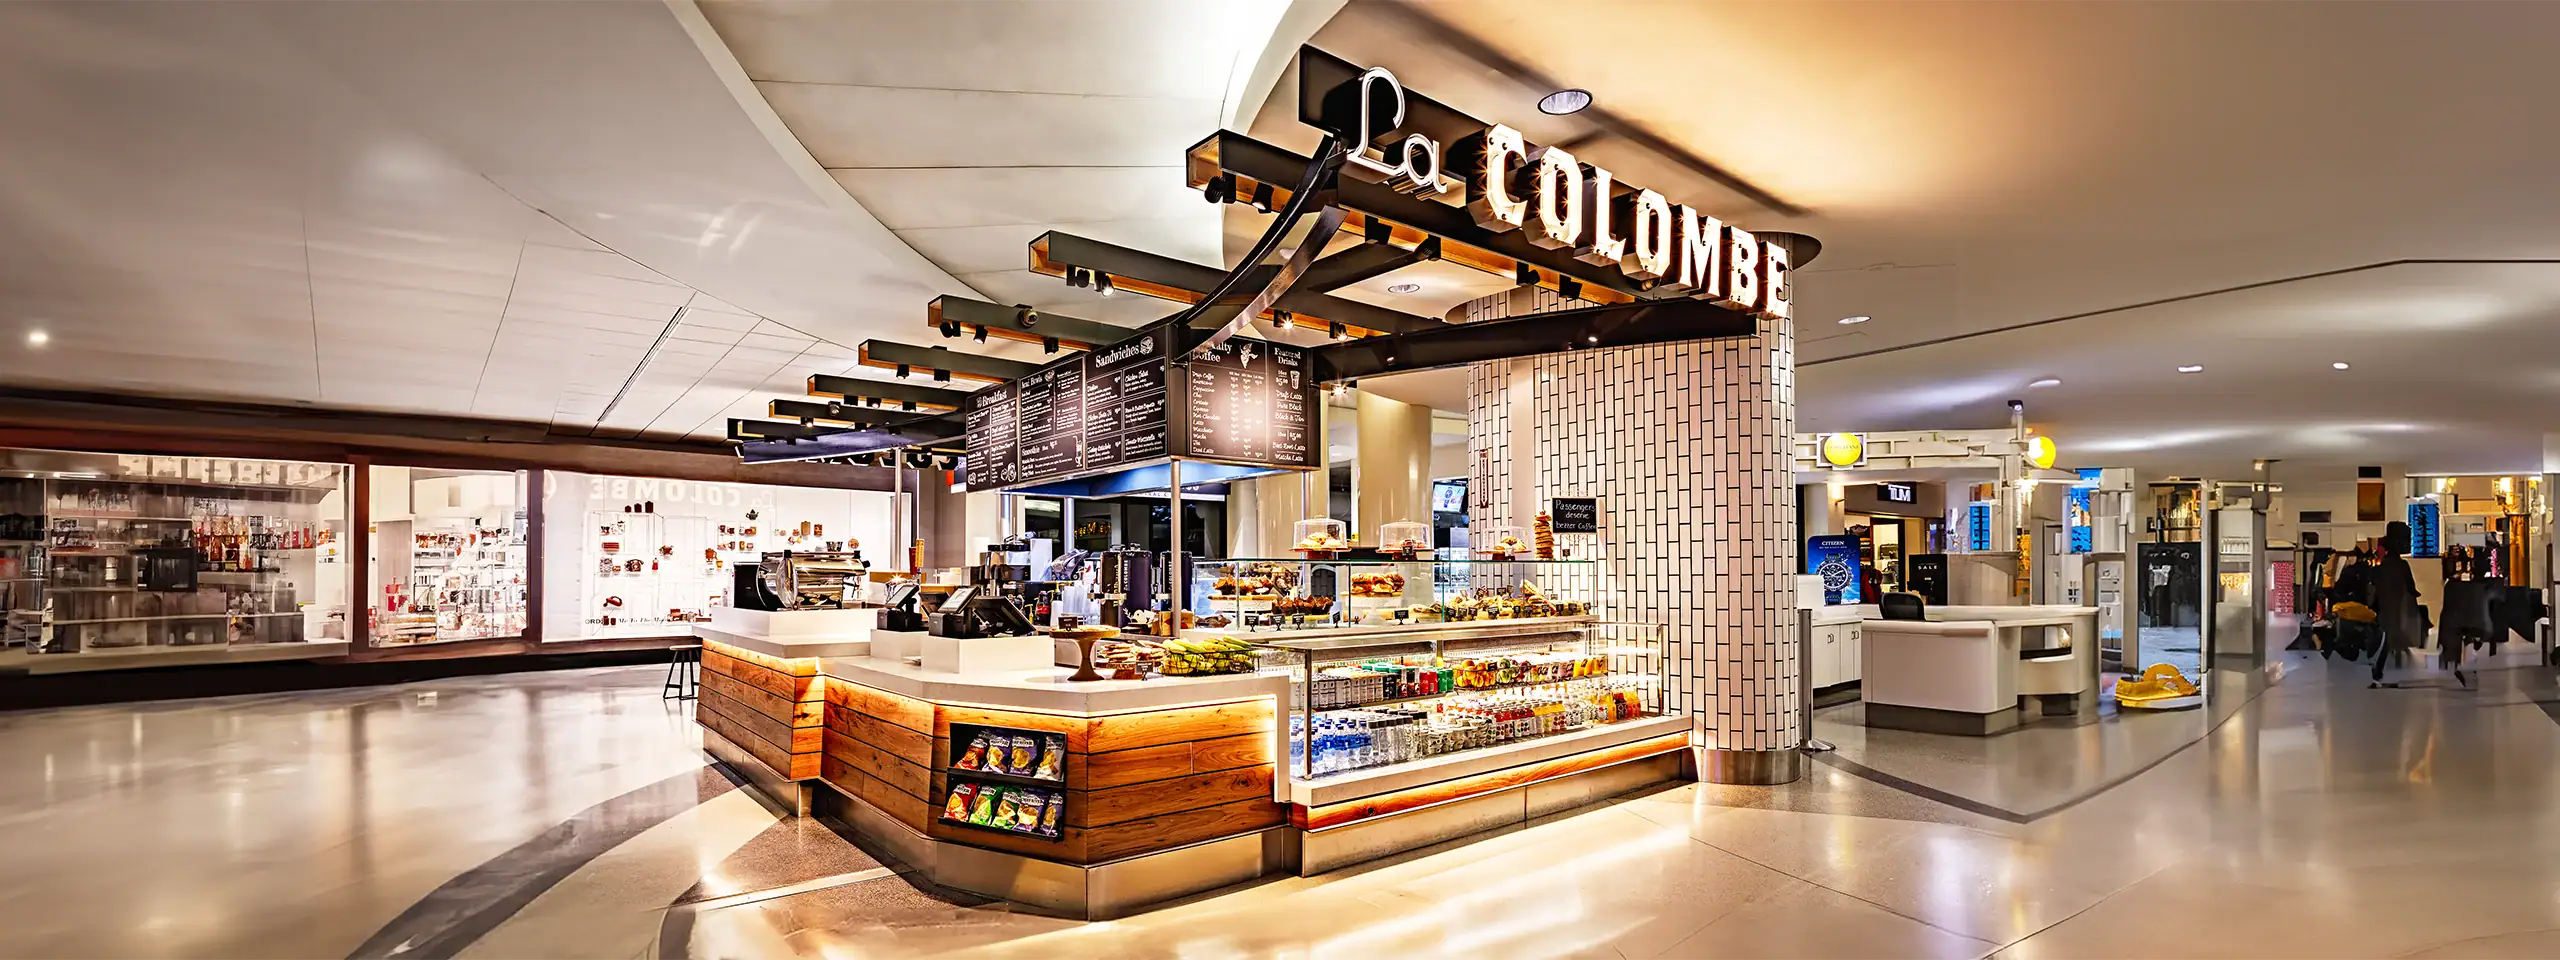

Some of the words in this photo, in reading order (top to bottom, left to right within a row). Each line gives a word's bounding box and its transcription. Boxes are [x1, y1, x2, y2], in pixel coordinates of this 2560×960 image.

[1345, 66, 1448, 194] La
[1484, 121, 1792, 320] COLOMBE
[1095, 344, 1140, 368] Sandwiches
[1277, 356, 1298, 366] Drinks
[1555, 499, 1596, 513] Passengers
[1565, 511, 1590, 520] deserve
[1555, 520, 1577, 529] better
